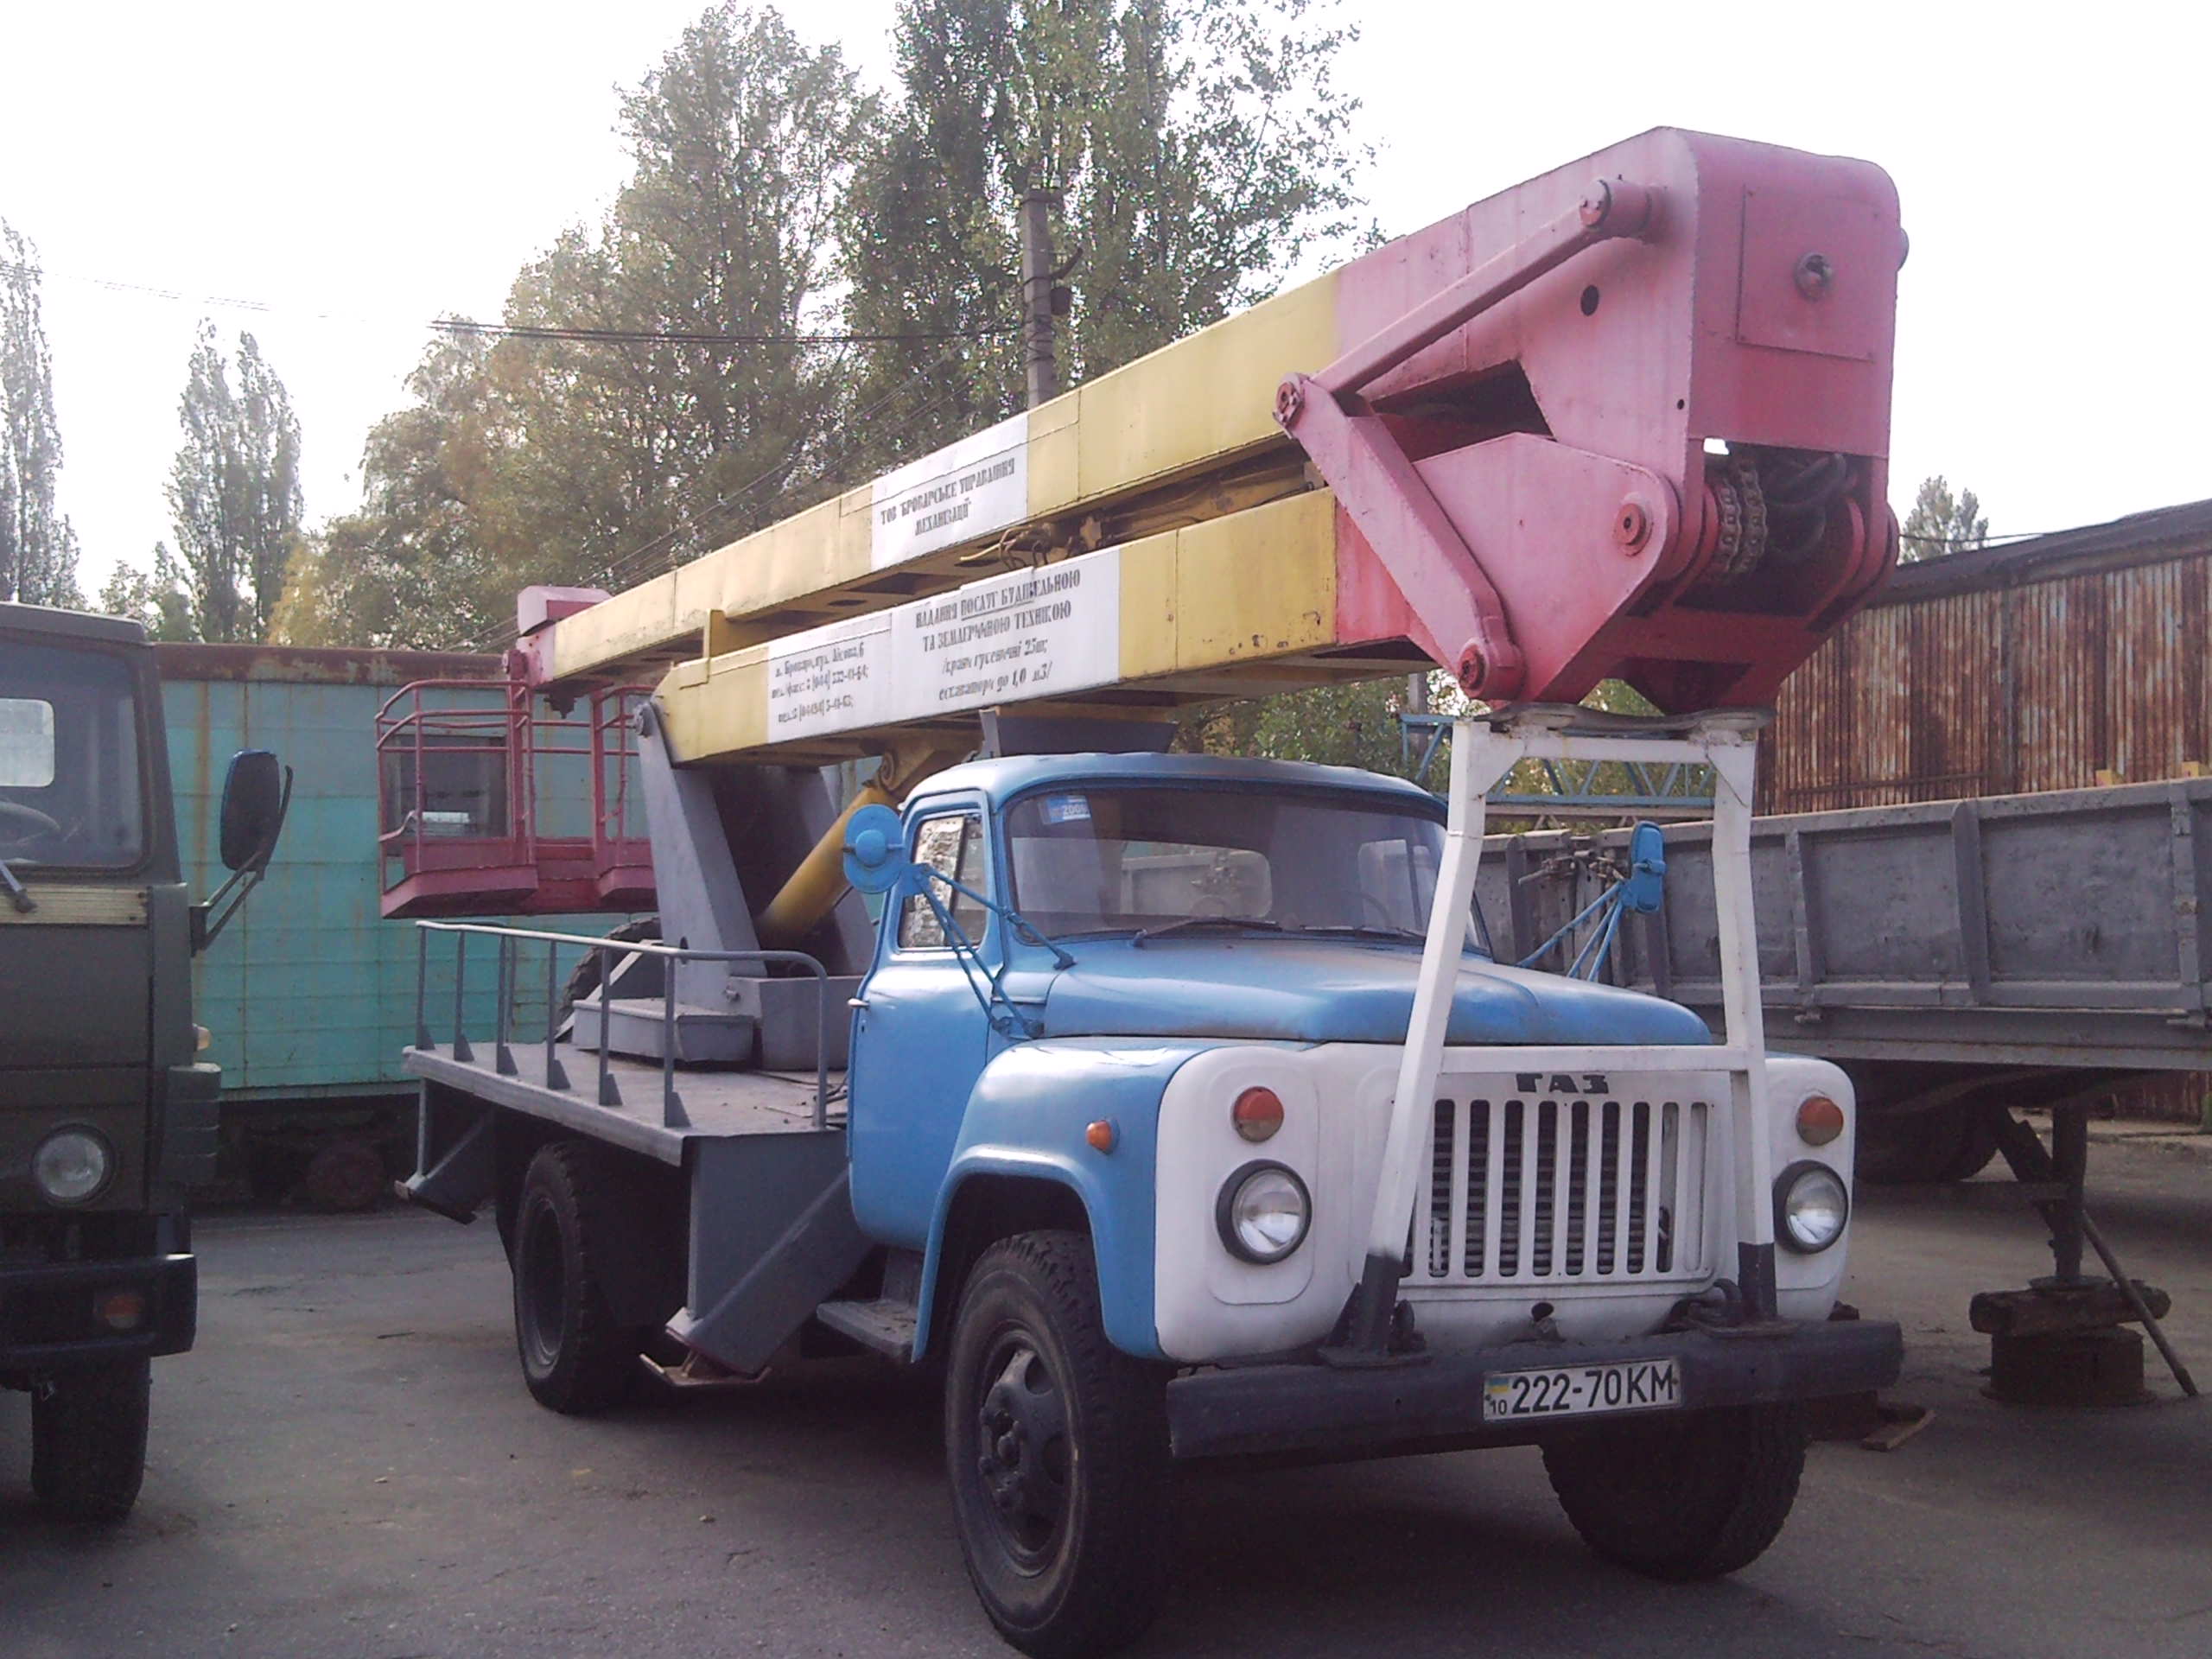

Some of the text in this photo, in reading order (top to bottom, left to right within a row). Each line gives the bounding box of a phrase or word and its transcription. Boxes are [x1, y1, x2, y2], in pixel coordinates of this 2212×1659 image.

[880, 505, 898, 525] ТОВ
[916, 602, 957, 629] НАДАННЯ
[961, 589, 997, 616] ПОСЛУГ
[923, 634, 936, 653] ТА
[1014, 600, 1072, 630] ТЕХНІКОЮ
[1516, 1072, 1609, 1095] ГАЗ
[1490, 1398, 1508, 1416] 10
